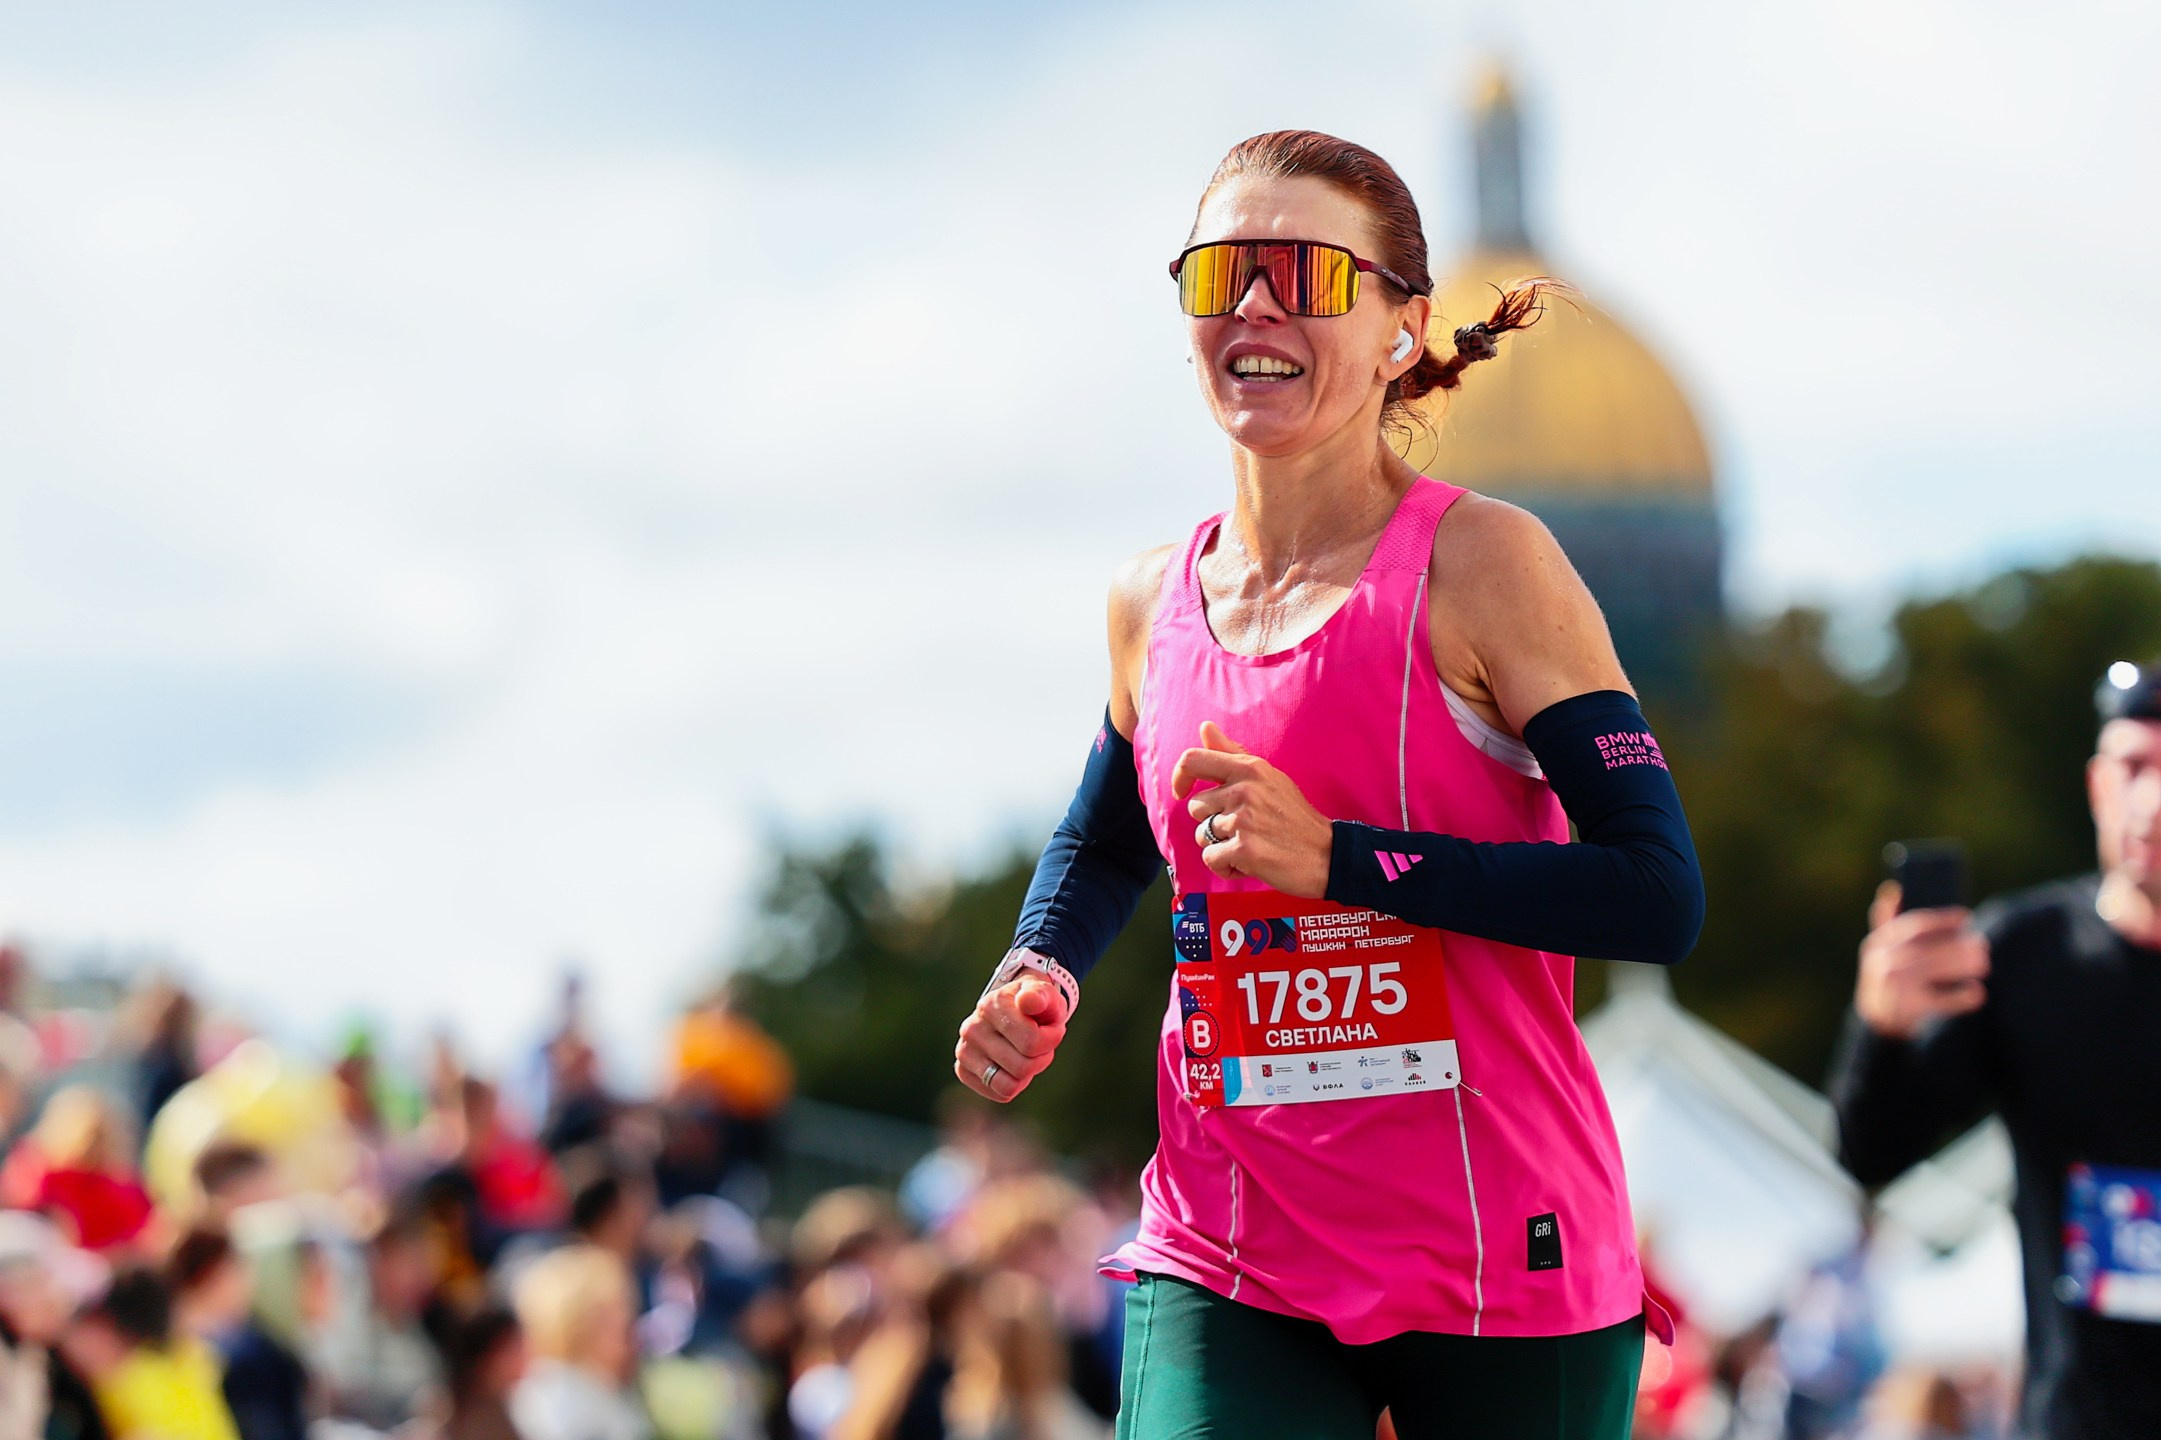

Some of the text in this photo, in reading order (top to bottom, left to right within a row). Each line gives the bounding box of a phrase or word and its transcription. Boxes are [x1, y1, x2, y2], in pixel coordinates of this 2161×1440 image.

[1594, 731, 1640, 750] BMW
[1601, 745, 1647, 760] BERLIN
[1189, 922, 1205, 933] ВТБ
[1298, 910, 1397, 928] ПЕТЕРБУРГС
[1300, 925, 1370, 942] МАРАФОН
[1302, 934, 1415, 953] ПУШКИН ПЕТЕРБУРГ
[1237, 961, 1408, 1025] 17875
[1265, 1022, 1378, 1048] СВЕТЛАНА
[1190, 1063, 1221, 1081] 42,2
[1200, 1081, 1214, 1090] КМ
